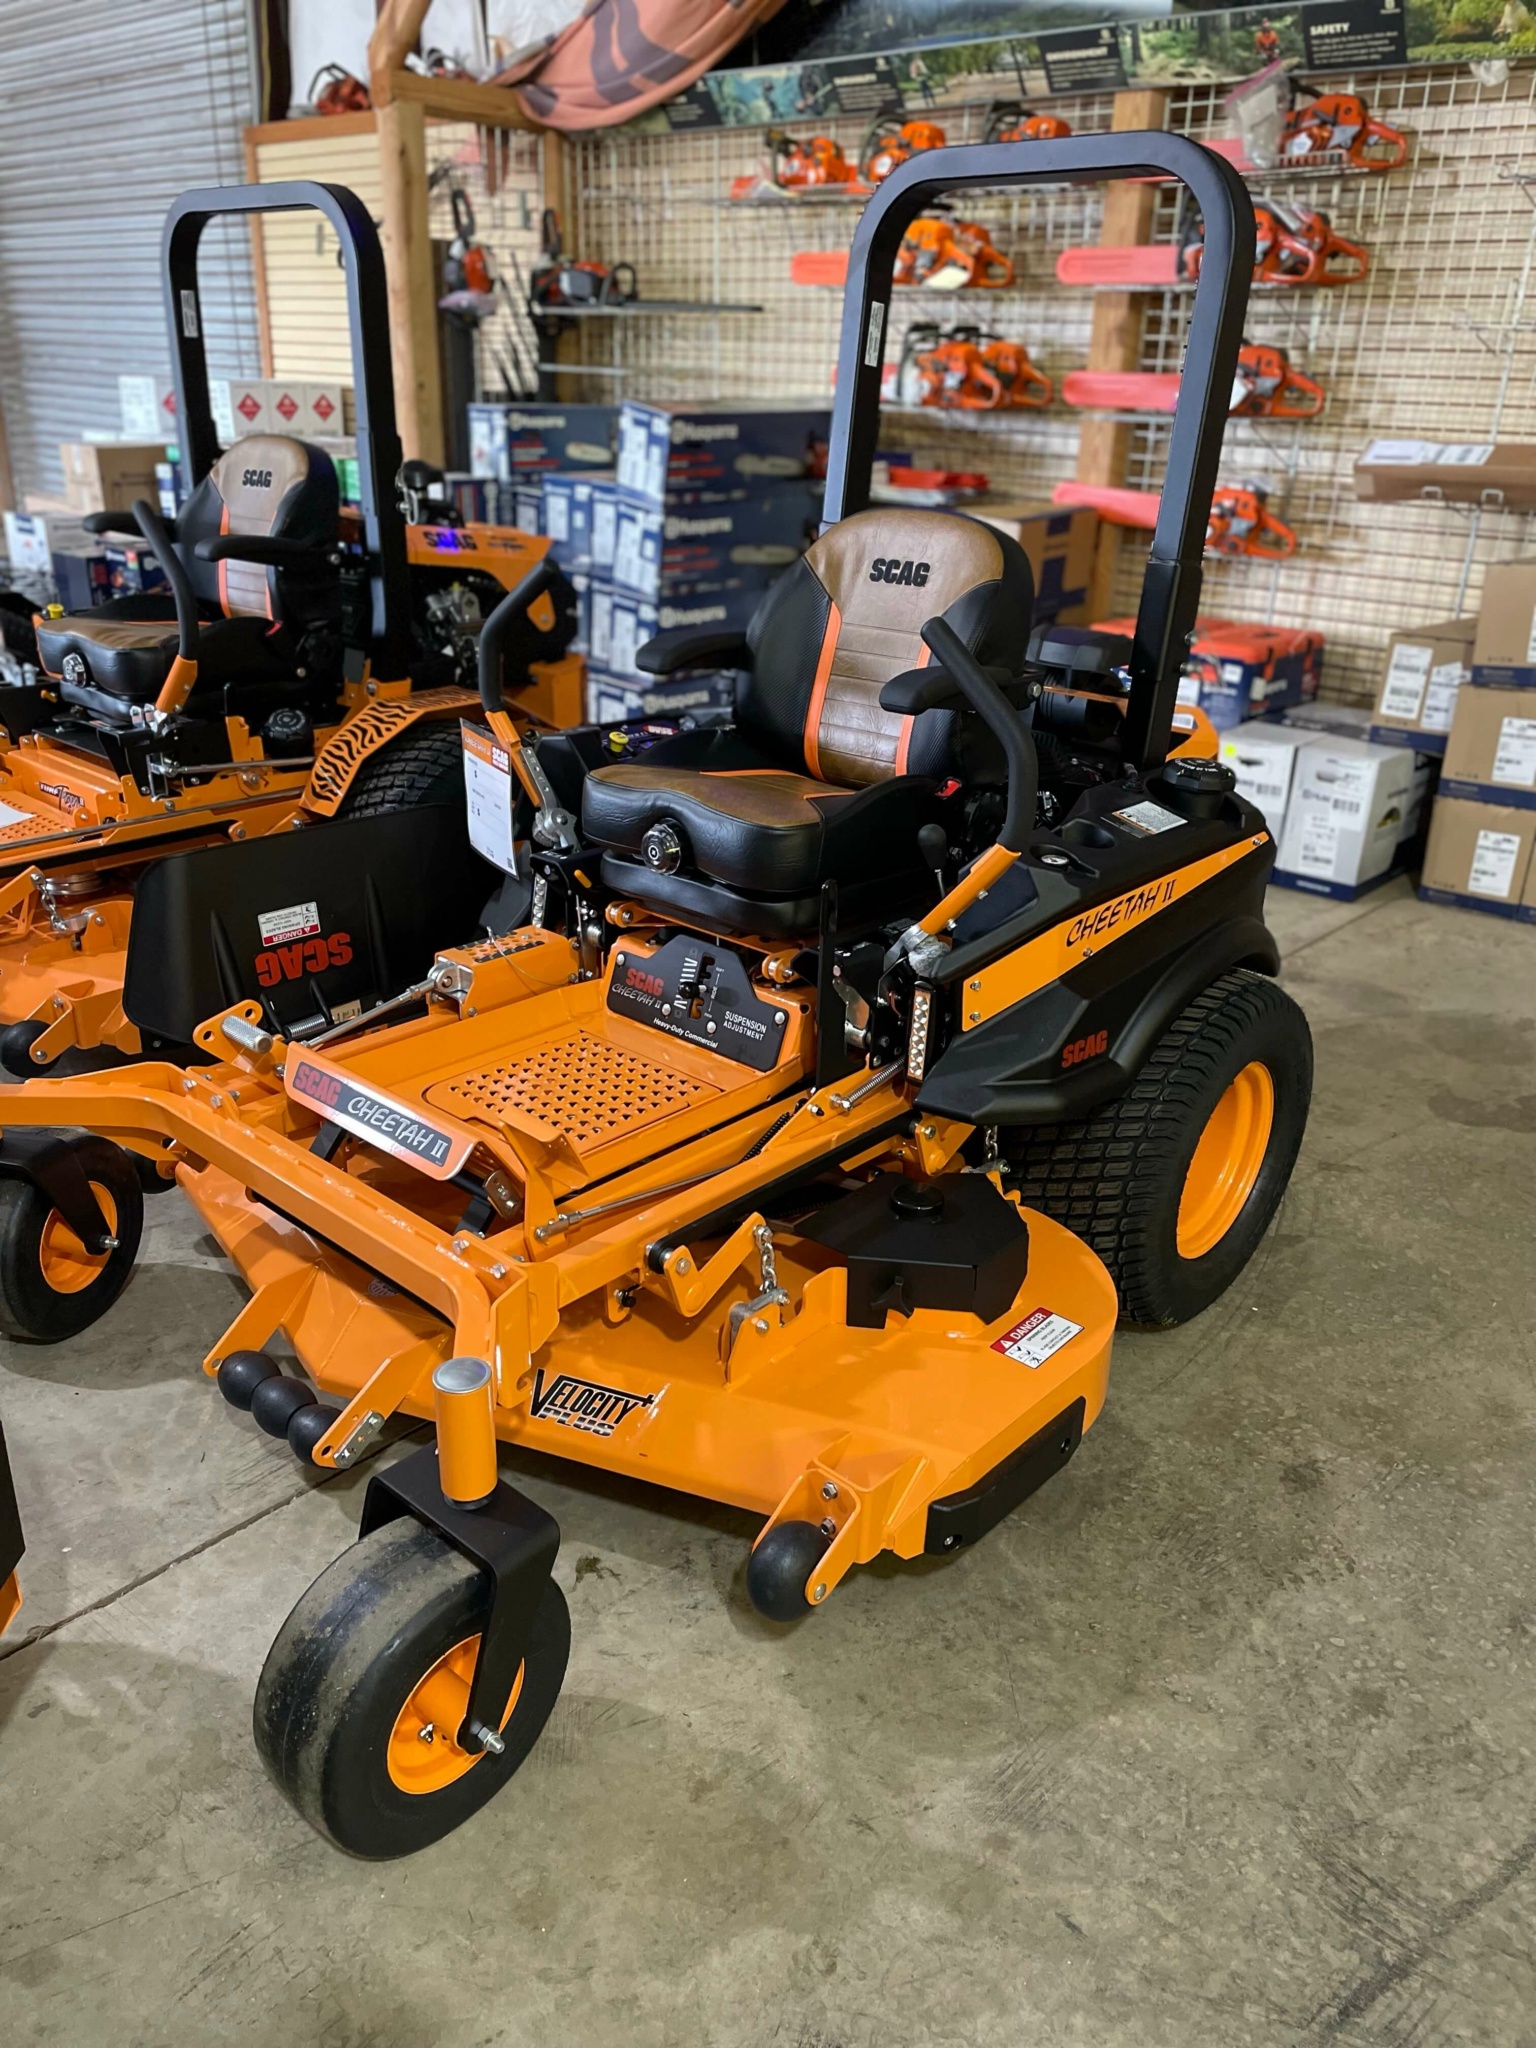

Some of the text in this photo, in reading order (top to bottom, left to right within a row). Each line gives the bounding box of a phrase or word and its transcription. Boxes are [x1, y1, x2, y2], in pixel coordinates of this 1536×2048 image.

[1310, 22, 1350, 36] SAFETY
[242, 469, 272, 488] SCAG
[869, 558, 931, 588] SCAG
[1066, 879, 1177, 947] CHEETAH II
[272, 928, 302, 942] DANGER
[255, 932, 353, 987] SCAG
[611, 983, 655, 1006] CHEETAH
[626, 967, 665, 996] SCAG
[653, 1017, 719, 1049] Heavy-Duty Commercial
[723, 1020, 765, 1041] ADJUSTMENT
[725, 1010, 767, 1034] SUSPENSION
[1062, 1030, 1107, 1068] SCAG
[295, 1065, 449, 1159] SCAG CHEETAH II
[1009, 1313, 1047, 1340] DANGER
[538, 1407, 615, 1437] PLUS
